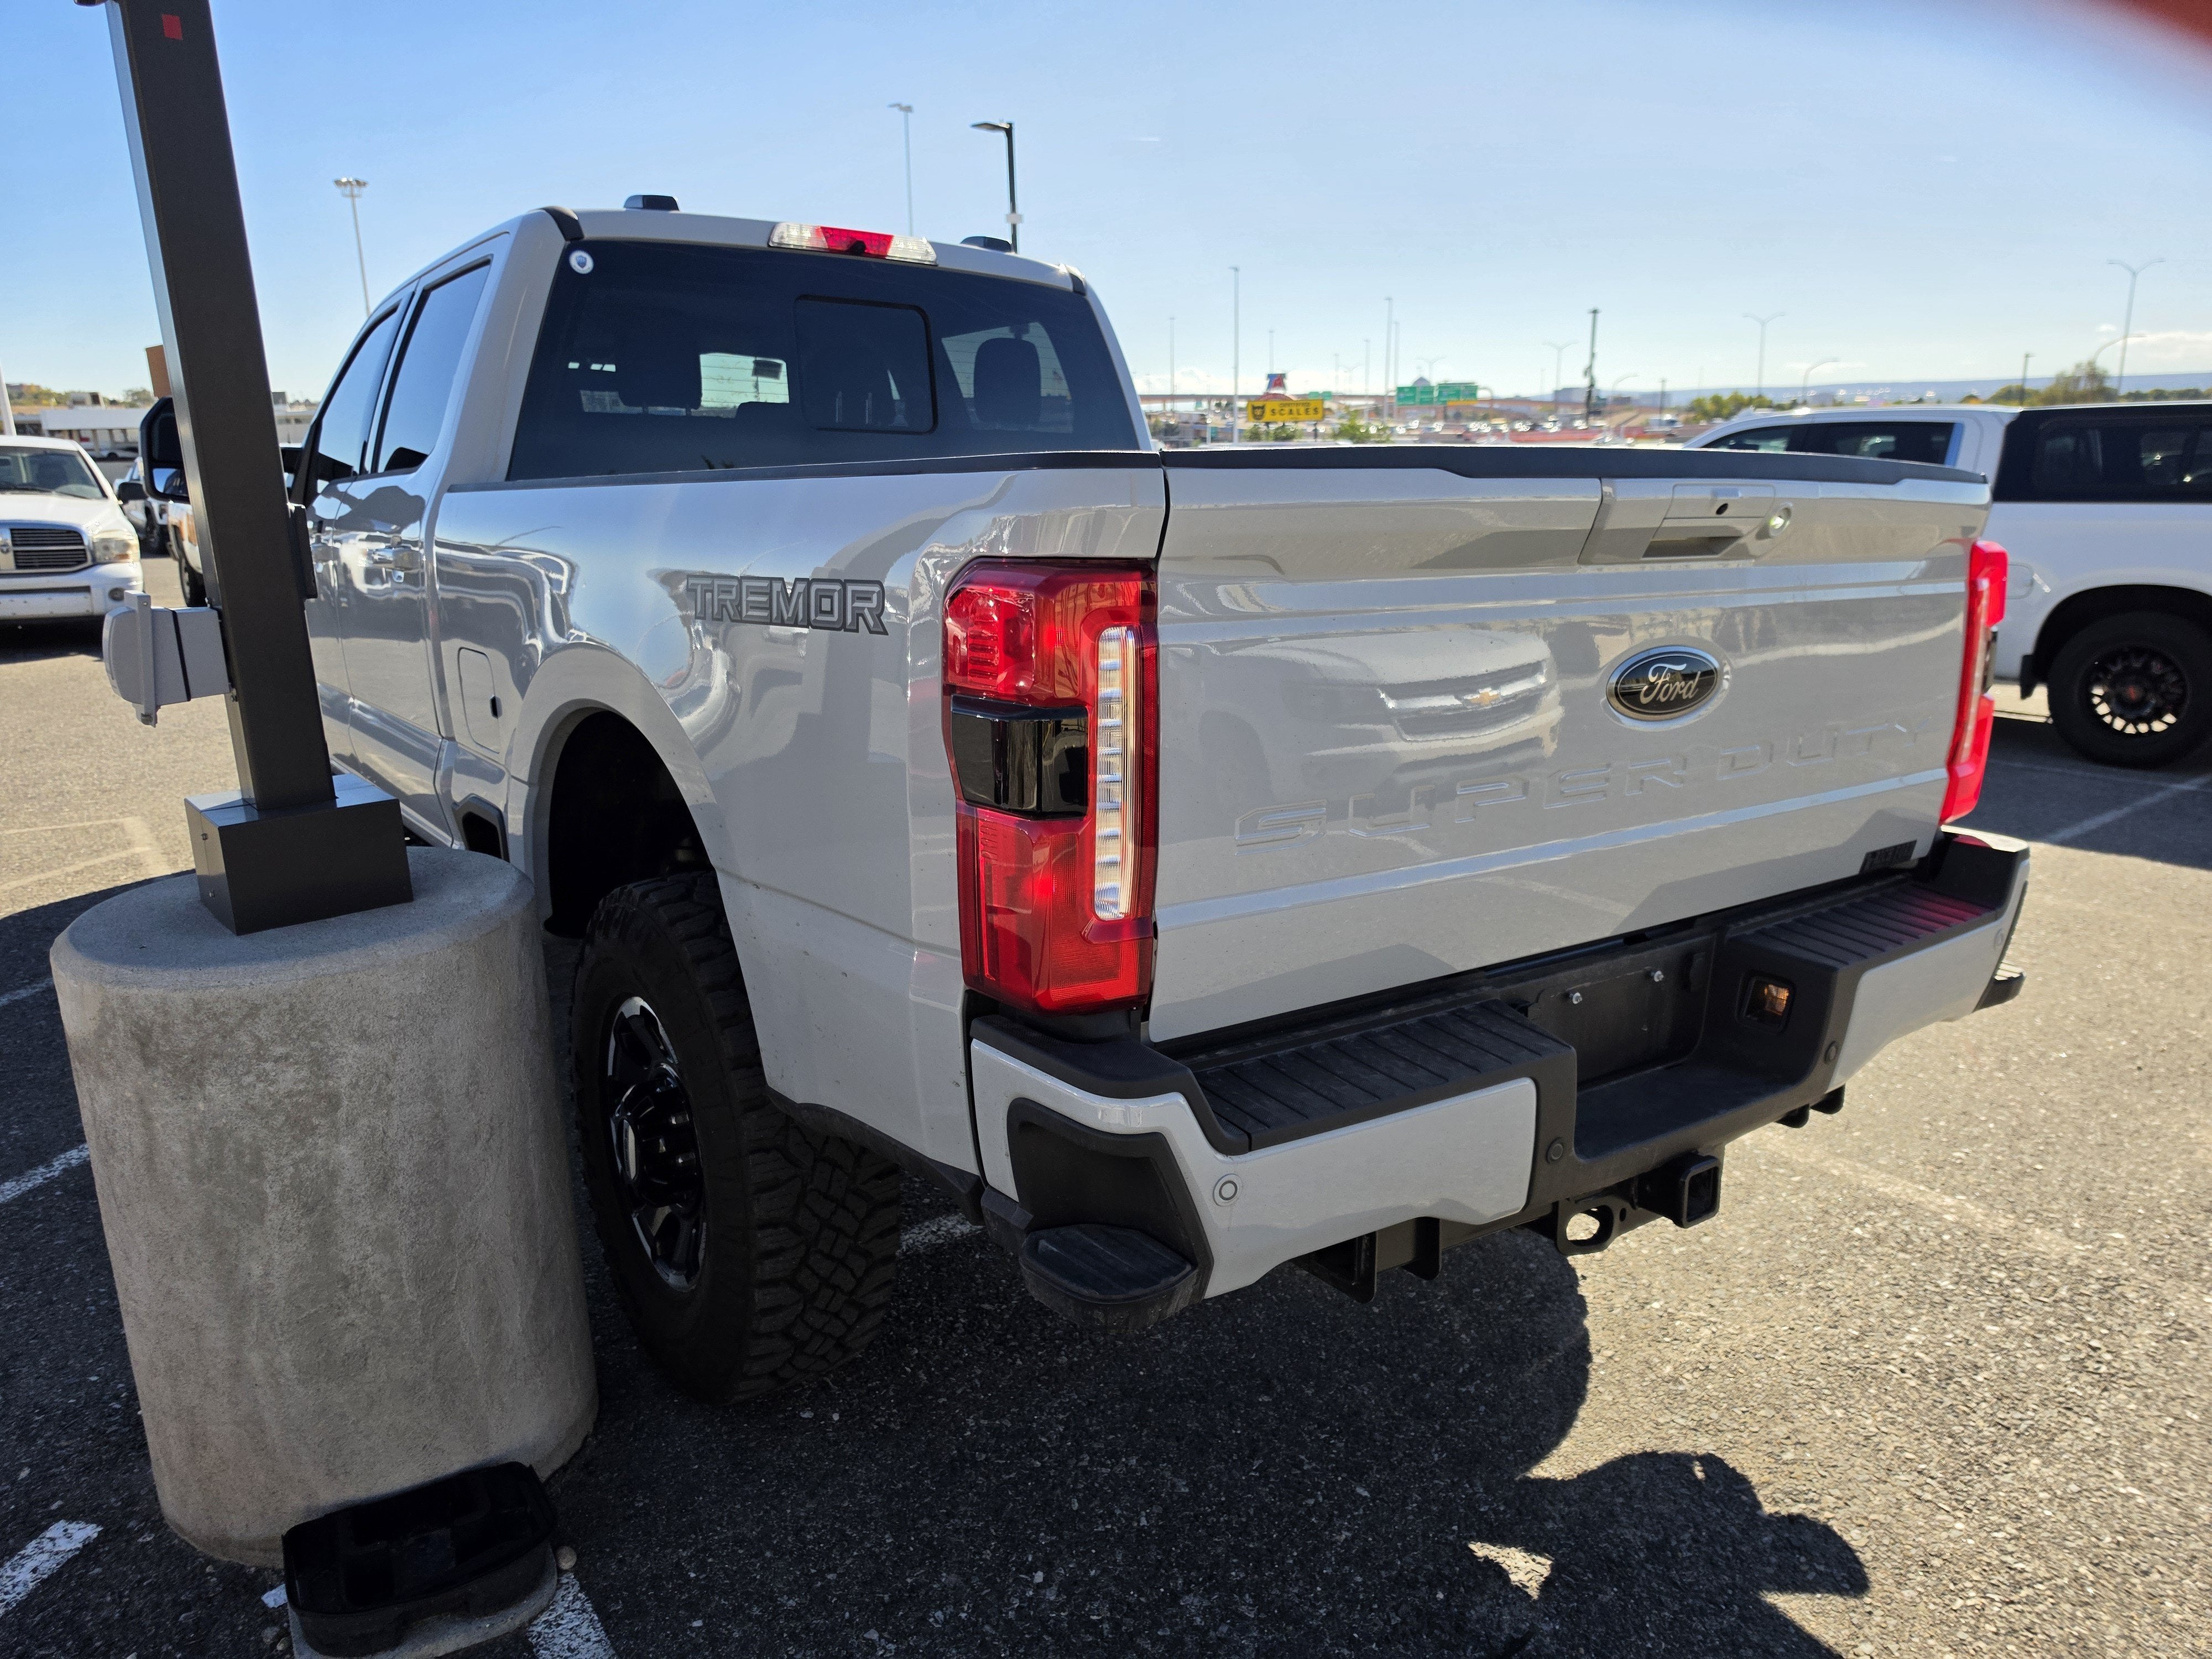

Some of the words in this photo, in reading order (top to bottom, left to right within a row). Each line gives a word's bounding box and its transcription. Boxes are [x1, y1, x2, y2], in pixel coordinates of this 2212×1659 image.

[1271, 407, 1319, 416] SCALES
[687, 575, 889, 635] TREMOR
[1640, 663, 1701, 705] Ford
[1234, 752, 1688, 856] SUPER
[1717, 717, 1933, 781] DUTY
